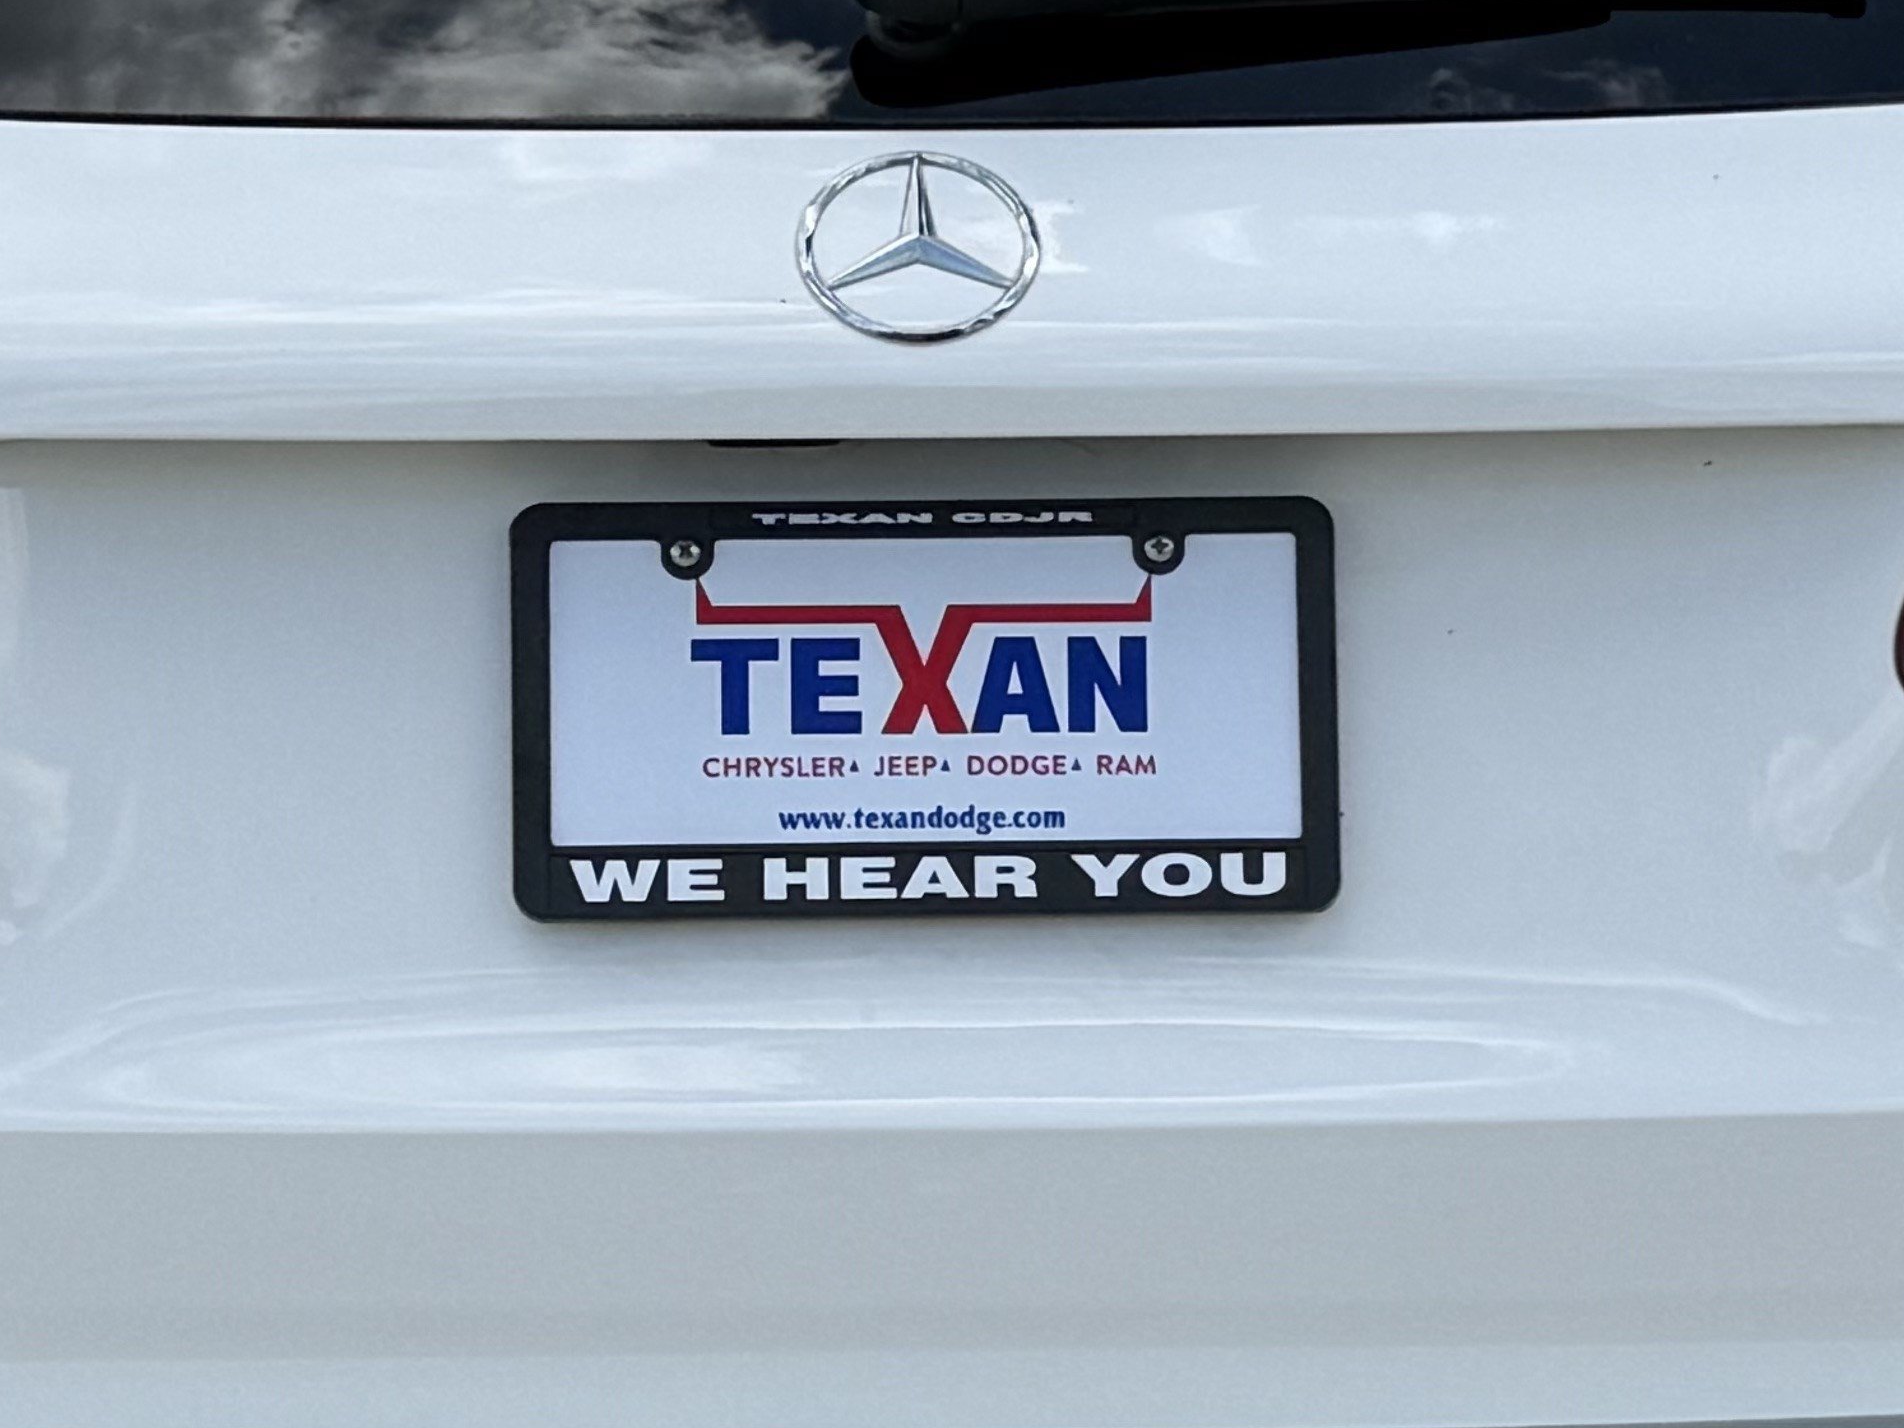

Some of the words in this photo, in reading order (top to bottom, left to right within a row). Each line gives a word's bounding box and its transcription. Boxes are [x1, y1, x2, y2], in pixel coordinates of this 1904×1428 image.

[752, 512, 933, 525] TEXAN
[952, 511, 1093, 523] CDJR
[690, 602, 1151, 735] TEXAN
[702, 755, 846, 778] CHRYSLER
[873, 755, 938, 777] JEEP
[966, 753, 1068, 776] DODGE
[1096, 753, 1157, 776] RAM
[778, 804, 1066, 835] www.texandodge.com
[570, 857, 726, 903] WE
[763, 855, 1038, 901] HEAR
[1070, 851, 1288, 898] YOU
